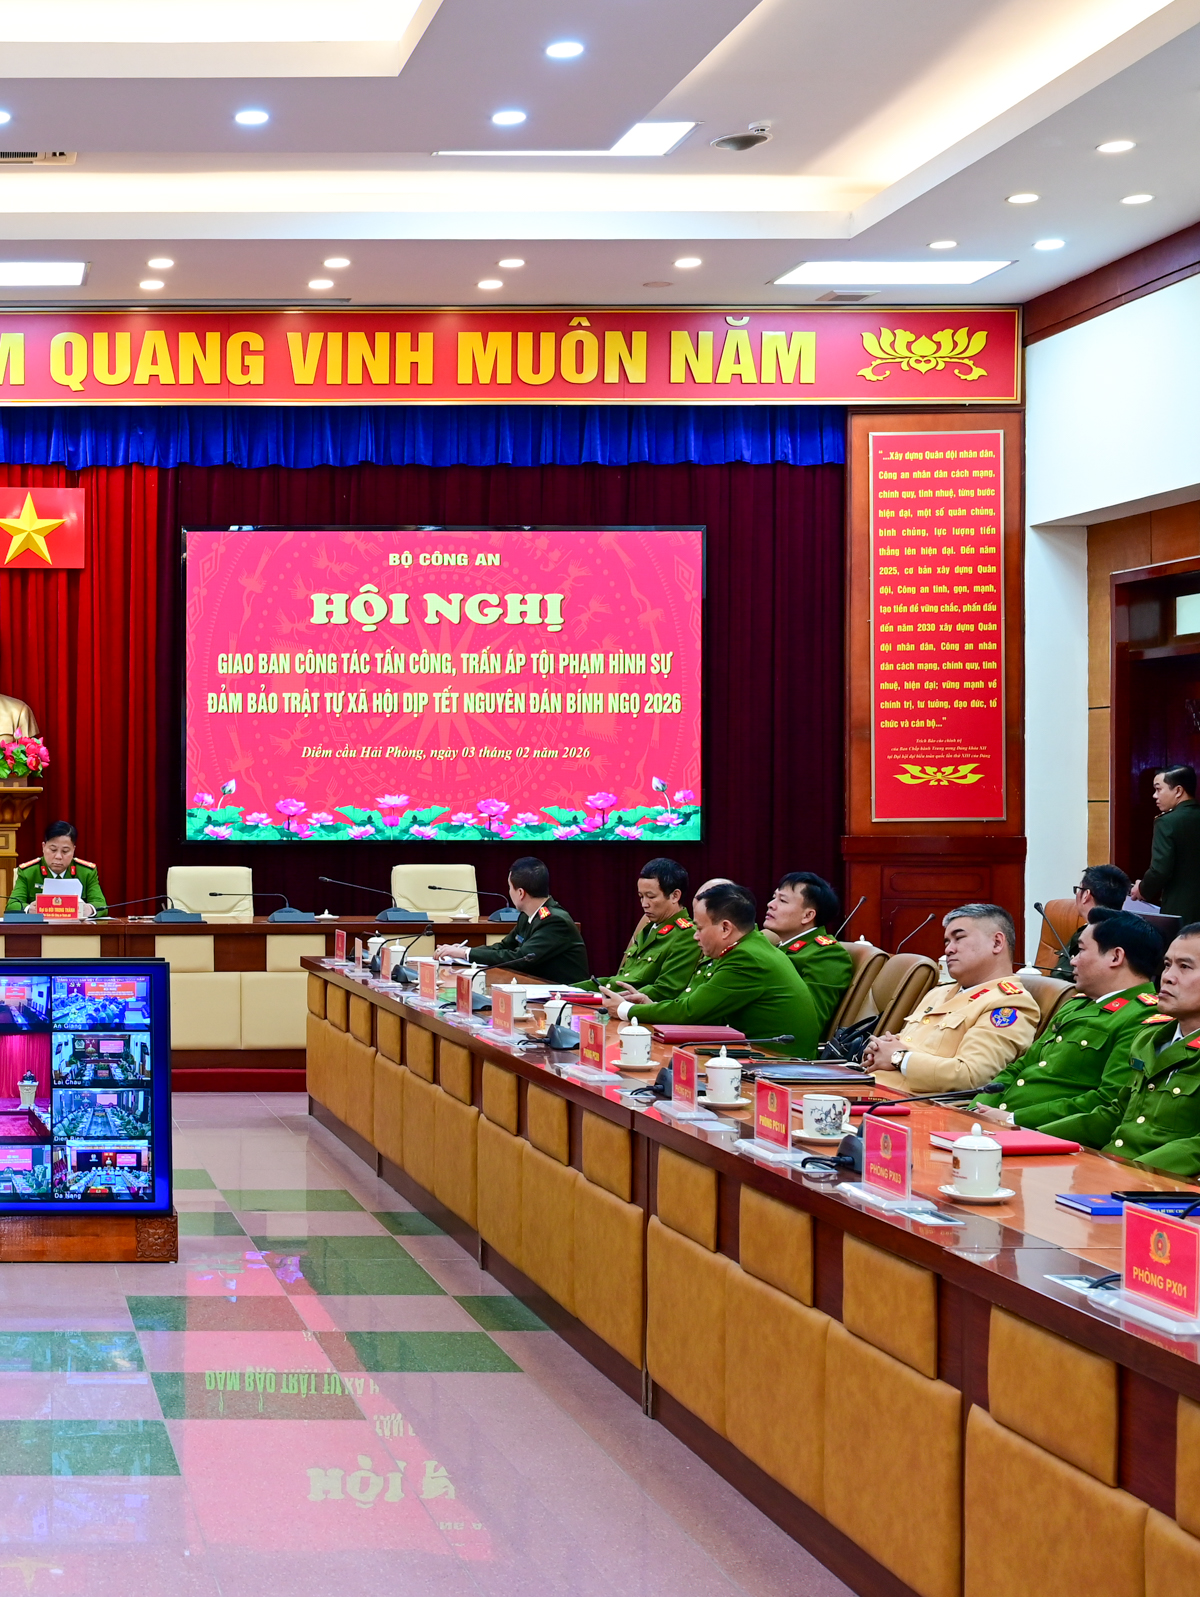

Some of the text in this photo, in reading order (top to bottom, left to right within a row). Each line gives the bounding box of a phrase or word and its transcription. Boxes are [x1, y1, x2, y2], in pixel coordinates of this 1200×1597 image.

[49, 330, 266, 392] QUANG
[286, 331, 434, 386] VINH
[456, 316, 648, 386] MUÔN
[669, 316, 817, 385] NĂM
[879, 507, 995, 518] hiện đại, một số quân chủng,
[389, 551, 500, 568] BỘ CÔNG AN
[879, 567, 899, 575] 2025,
[918, 565, 932, 574] bản
[937, 566, 950, 574] xây
[955, 566, 972, 575] dựng
[978, 565, 996, 573] Quân
[310, 584, 564, 632] HỘI NGHỊ
[880, 623, 894, 632] đến
[898, 624, 913, 632] năm
[940, 623, 952, 632] xây
[956, 623, 974, 632] dựng
[978, 622, 997, 631] Quân
[218, 646, 673, 678] GIAO BAN CÔNG TÁC TẤN CÔNG, TRẤN ÁP TỘI PHẠM HÌNH SỰ
[207, 684, 681, 718] ĐẢM BẢO TRẬT TỰ XÃ HỘI DỊP TẾT NGUYÊN ĐÁN BÍNH NGỌ 2026
[880, 720, 898, 728] chức
[911, 719, 924, 727] cán
[302, 744, 590, 760] Điểm cầu Hải Phòng, ngày 03 tháng 02 năm 2026
[759, 1114, 772, 1129] PHÒNG
[870, 1163, 888, 1179] PHÒNG
[1133, 1267, 1187, 1298] PHÒNG PX01
